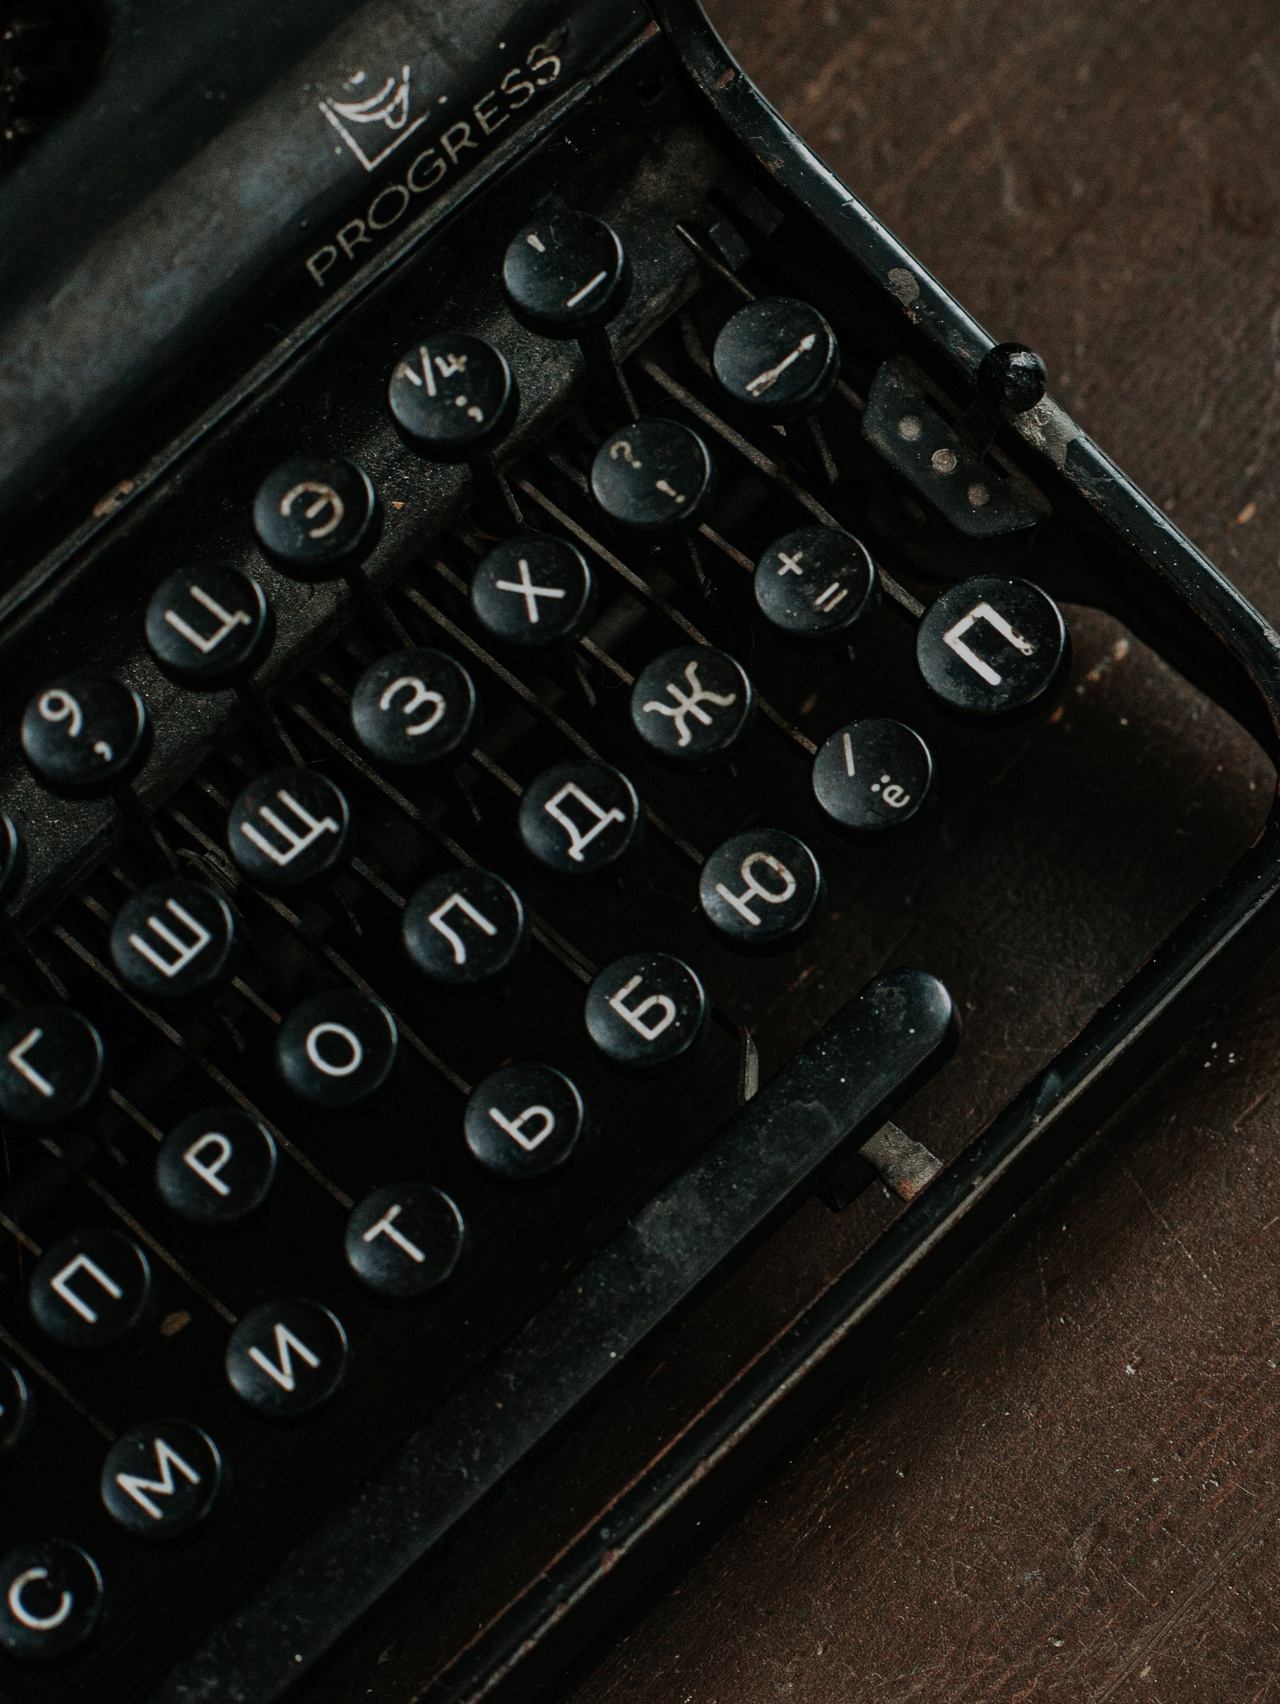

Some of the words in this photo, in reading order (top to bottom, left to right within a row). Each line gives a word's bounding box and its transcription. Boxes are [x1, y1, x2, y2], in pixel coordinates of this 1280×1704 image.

[305, 43, 563, 288] PROGRESS
[608, 439, 643, 470] ?
[279, 482, 345, 539] Э
[163, 585, 252, 654] Ц
[942, 600, 1037, 687] П
[37, 688, 83, 738] 9
[643, 660, 736, 748] Ж
[240, 789, 339, 867] Щ
[544, 776, 627, 863] Д
[713, 851, 797, 926] Ю
[127, 898, 211, 977] Ш
[427, 892, 498, 966] Л
[609, 974, 677, 1042] Б
[7, 1027, 54, 1098] Г
[488, 1104, 556, 1153] Ь
[50, 1254, 123, 1323] П
[247, 1323, 320, 1393] И
